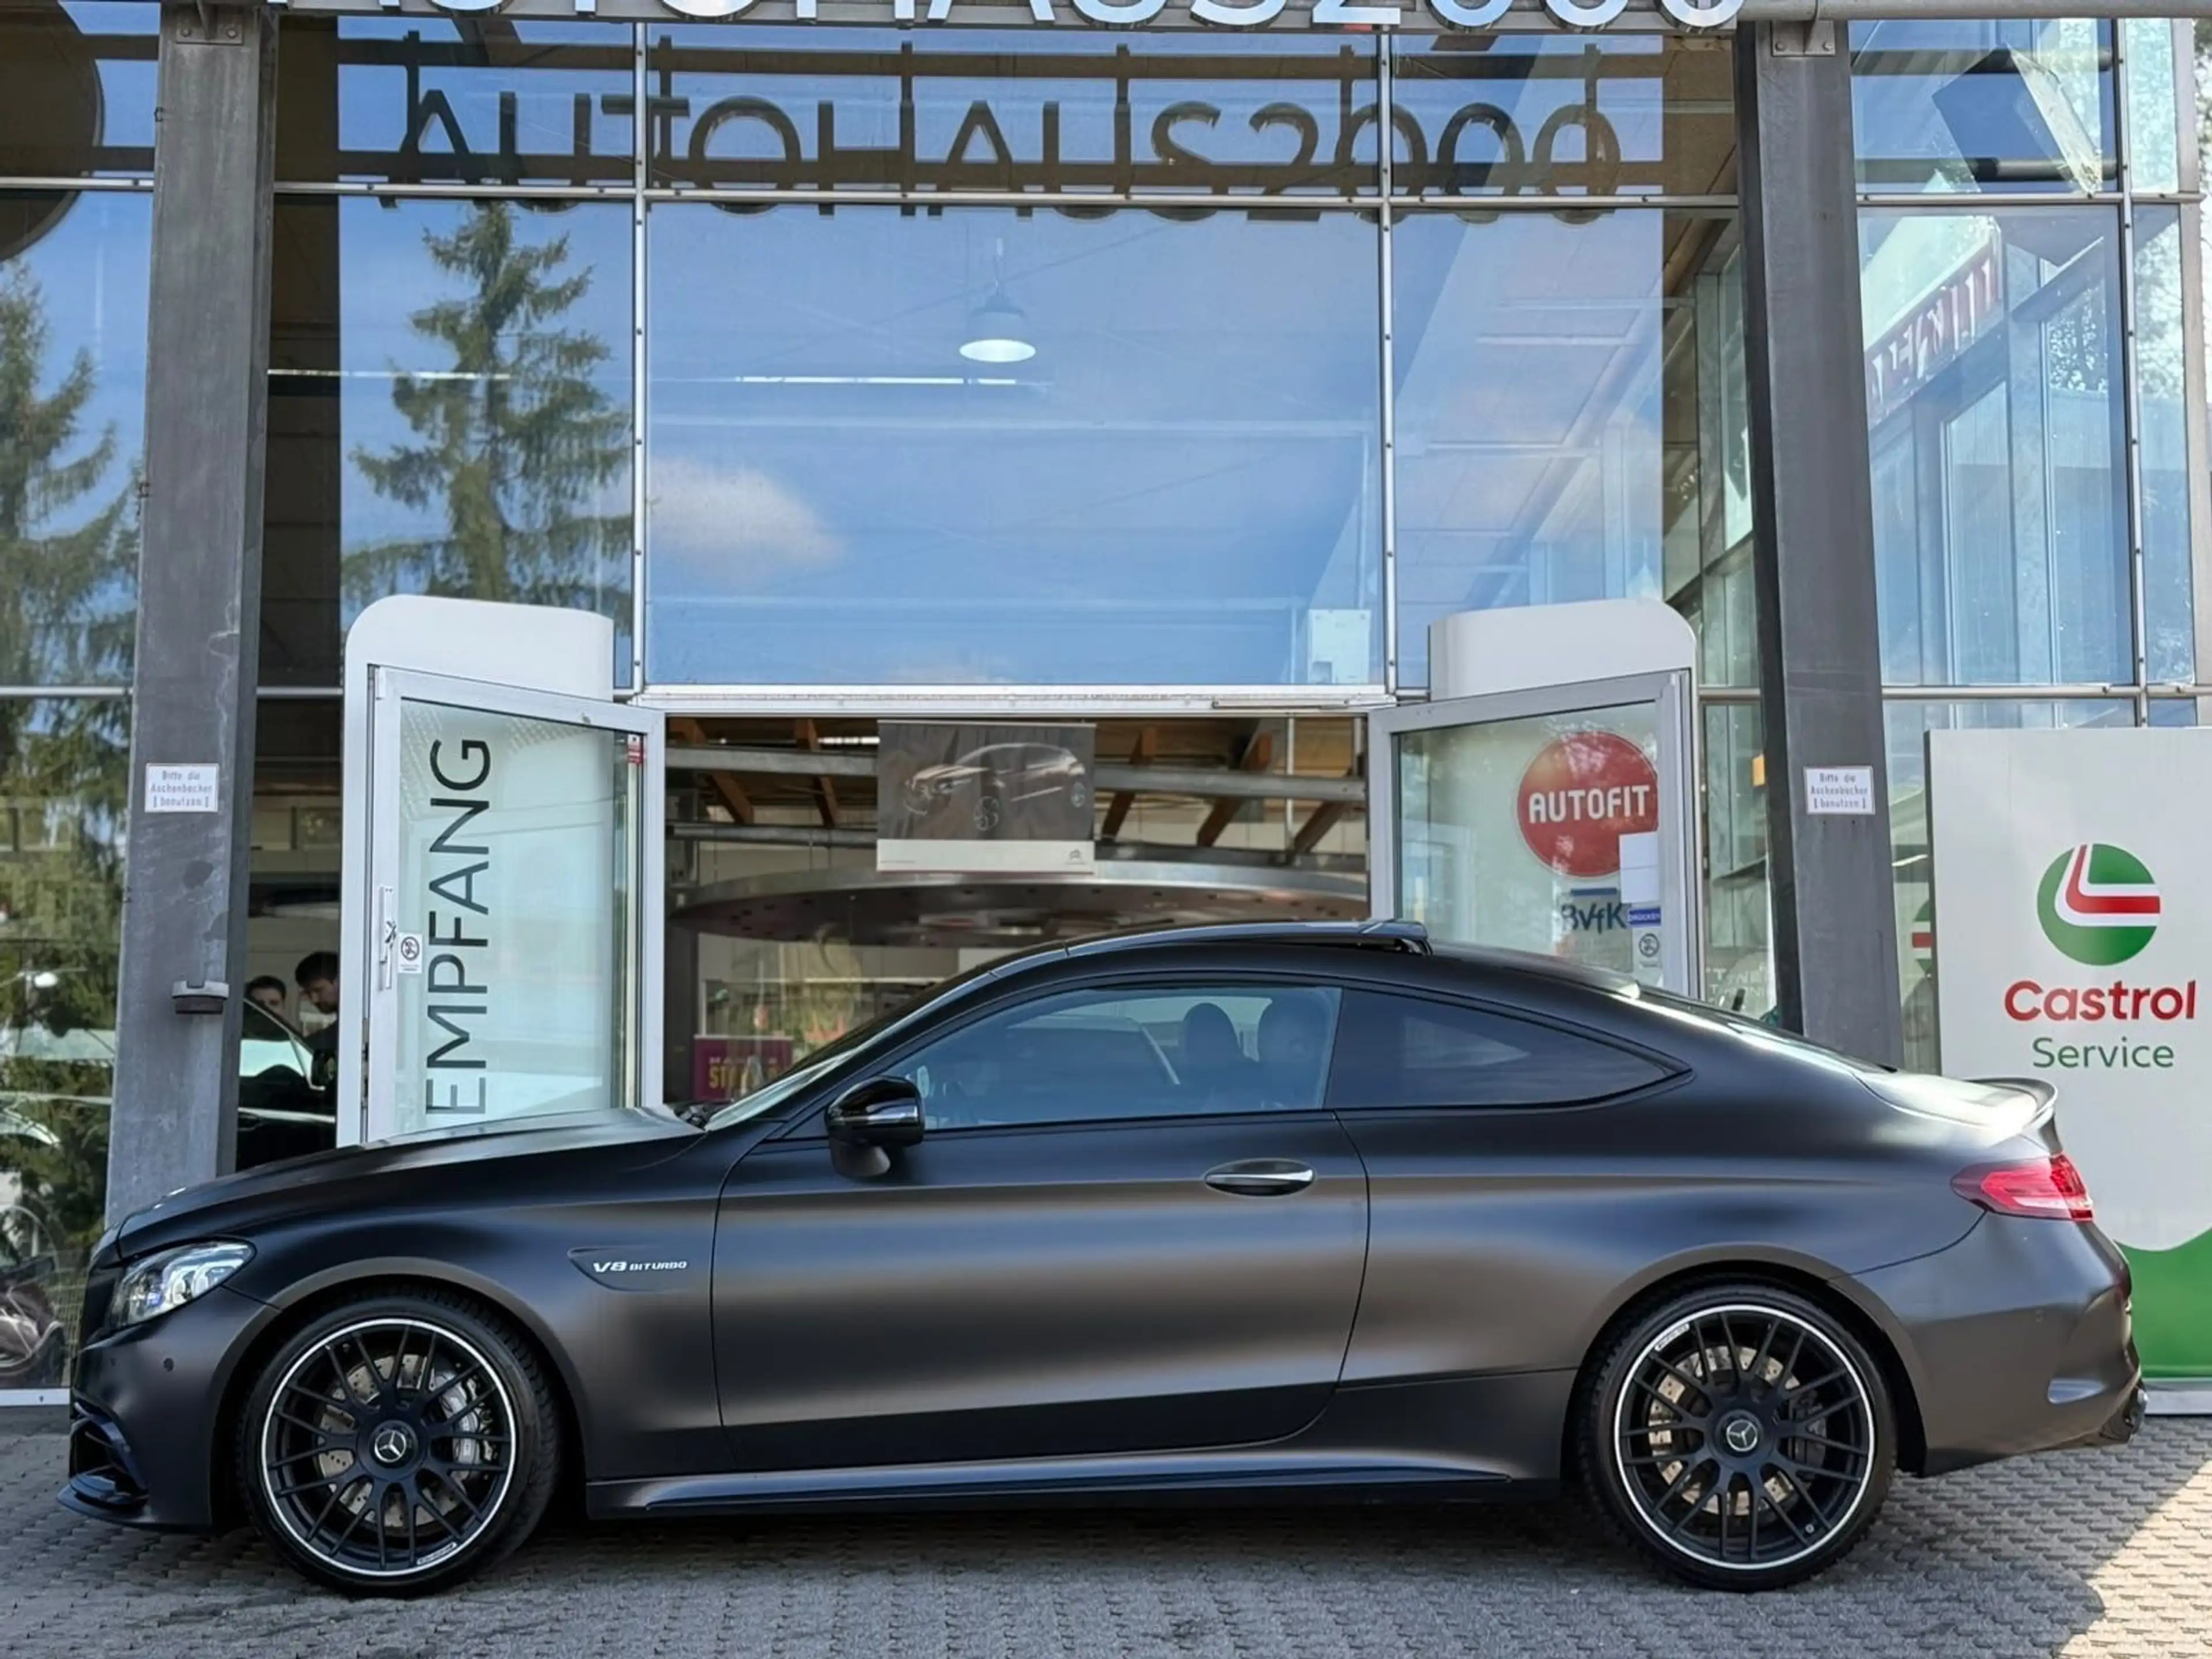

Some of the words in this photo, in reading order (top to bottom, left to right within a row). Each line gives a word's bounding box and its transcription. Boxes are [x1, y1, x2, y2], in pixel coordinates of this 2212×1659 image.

[162, 770, 183, 781] Bitte
[188, 770, 200, 780] die
[1819, 772, 1839, 783] Bitte
[1529, 784, 1650, 824] AUTOFIT
[425, 738, 491, 1115] EMPFANG
[2004, 979, 2196, 1021] Castrol
[2032, 1036, 2175, 1068] Service
[593, 1261, 627, 1273] V8
[628, 1261, 688, 1272] BITURBO
